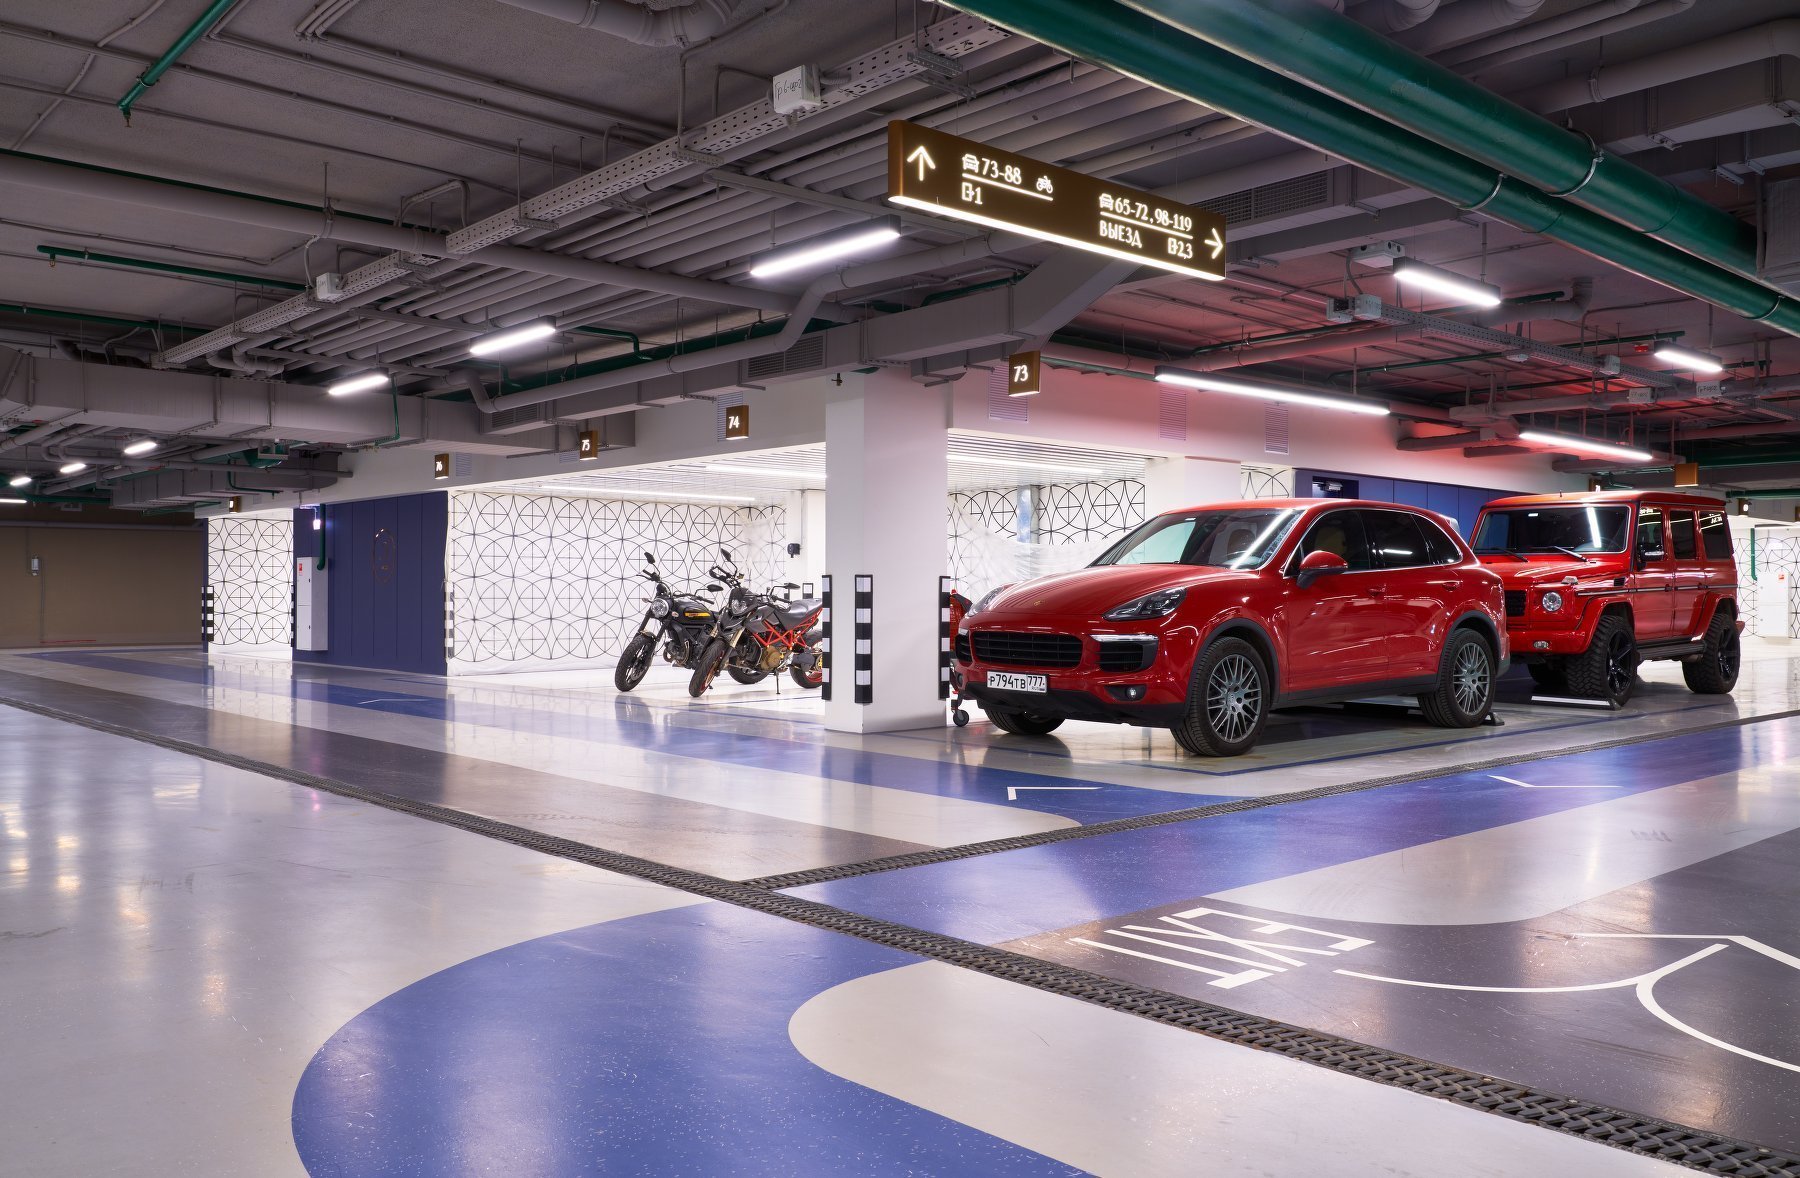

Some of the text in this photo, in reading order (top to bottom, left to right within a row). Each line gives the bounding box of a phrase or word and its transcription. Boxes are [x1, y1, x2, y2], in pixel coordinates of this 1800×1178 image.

[981, 157, 1022, 185] 73-88
[974, 186, 983, 205] 1
[1154, 208, 1192, 232] 98-119
[1099, 219, 1143, 249] ВЫЕЗД
[1013, 364, 1029, 383] 73
[728, 415, 740, 430] 74
[581, 439, 591, 451] 75
[435, 460, 443, 472] 76
[1068, 907, 1376, 989] EXIT
